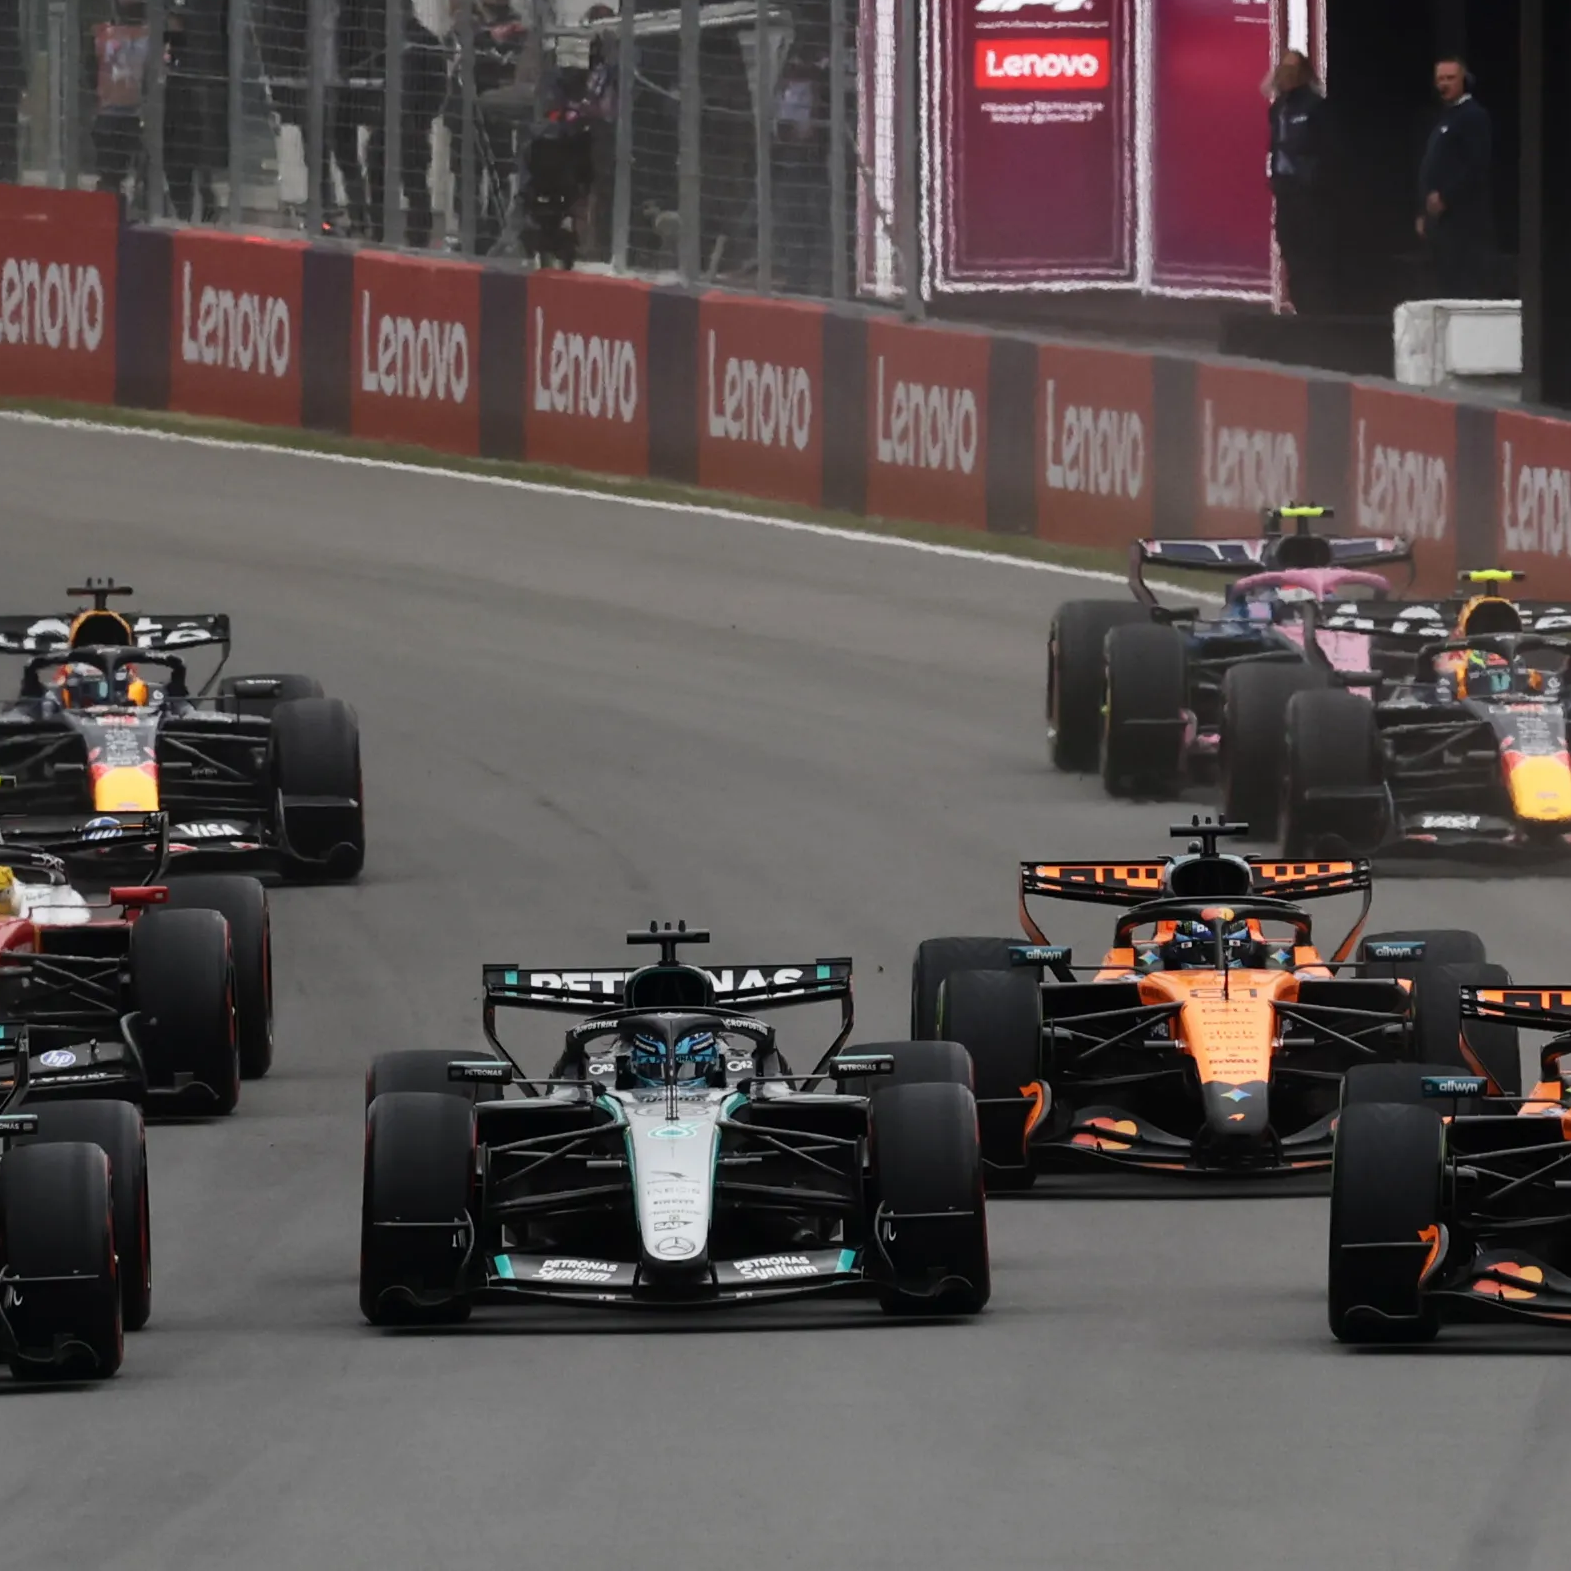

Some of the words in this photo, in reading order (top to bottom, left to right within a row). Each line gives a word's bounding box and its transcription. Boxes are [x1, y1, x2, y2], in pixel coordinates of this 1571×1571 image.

[985, 50, 1100, 80] Lenovo
[181, 261, 290, 377] Lenovo
[361, 290, 469, 403] Lenovo
[534, 306, 638, 423] Lenovo
[708, 330, 812, 451] Lenovo
[877, 356, 977, 474] Lenovo
[1045, 379, 1145, 499] Lenovo
[1203, 400, 1299, 509] Lenovo
[1357, 419, 1448, 538] Lenovo
[175, 823, 243, 837] VISA
[1026, 948, 1062, 961] allwyn
[1375, 945, 1411, 958] allwyn
[530, 967, 805, 1005] PETNAS
[464, 1069, 502, 1077] PETRONAS
[837, 1063, 877, 1071] PETRONAS
[1438, 1080, 1478, 1094] allwyn
[542, 1259, 618, 1272] PETRONAS
[733, 1255, 809, 1270] PETRONAS
[740, 1264, 818, 1280] Syntium
[532, 1267, 612, 1282] Syntium
